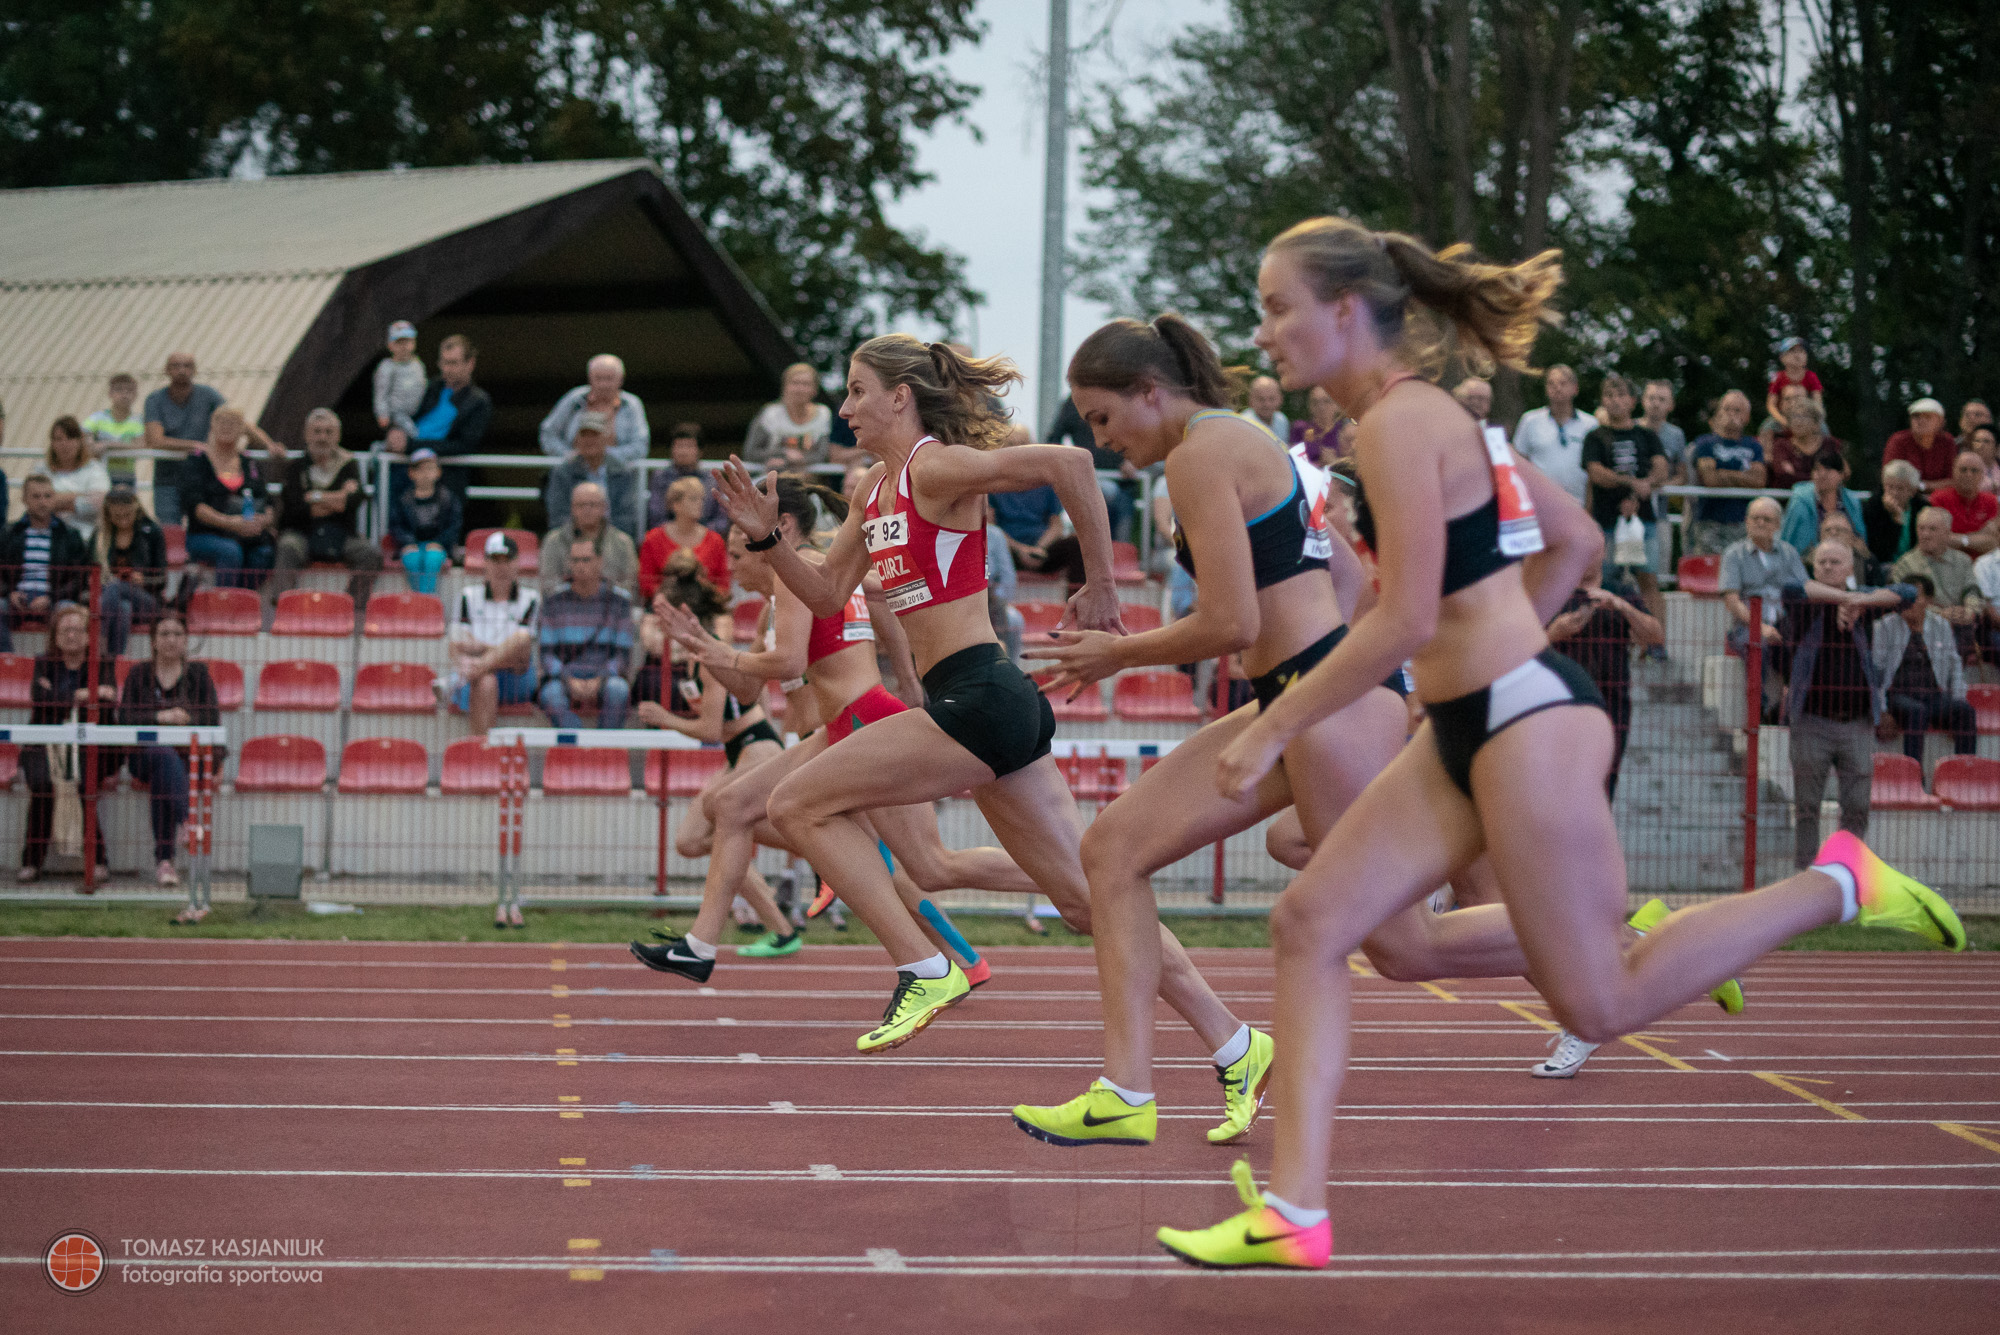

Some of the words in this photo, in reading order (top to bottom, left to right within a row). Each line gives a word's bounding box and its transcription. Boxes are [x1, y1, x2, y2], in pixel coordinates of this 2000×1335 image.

[882, 520, 900, 541] 92
[875, 555, 910, 581] CIARZ
[908, 592, 925, 605] 2018
